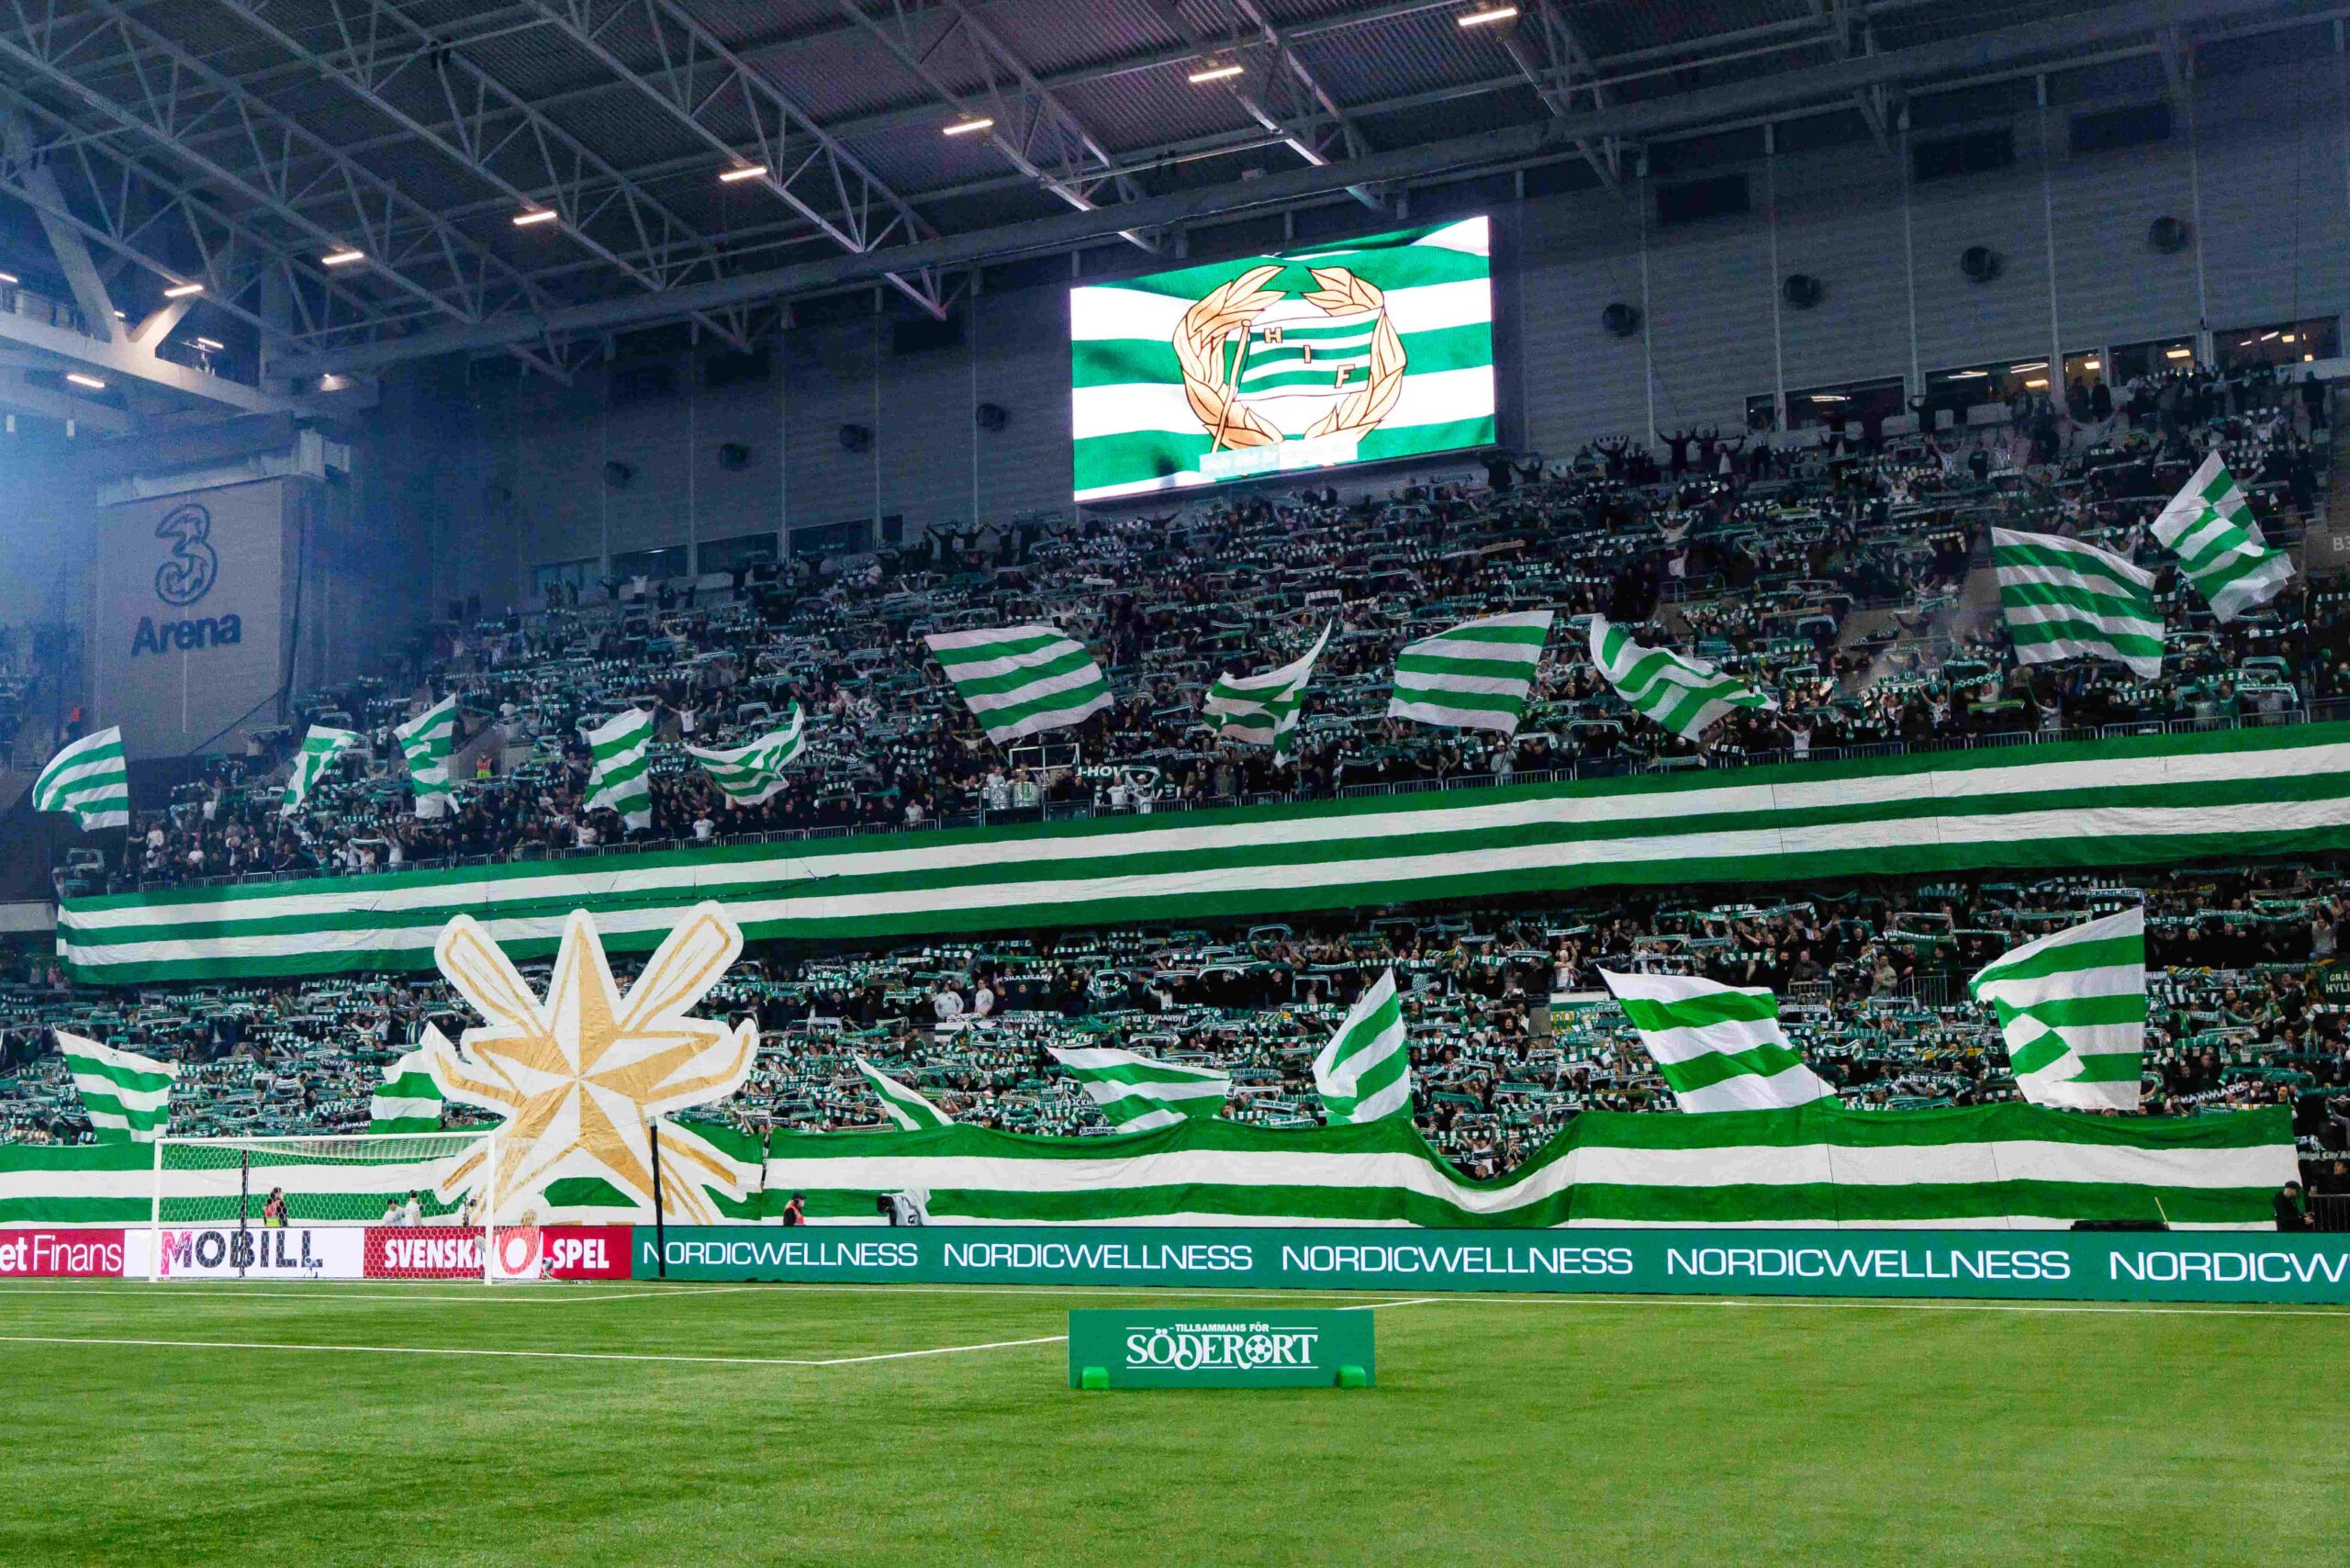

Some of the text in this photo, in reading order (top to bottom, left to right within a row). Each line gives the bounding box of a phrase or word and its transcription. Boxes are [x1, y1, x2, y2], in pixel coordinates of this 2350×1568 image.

[1263, 326, 1283, 344] H
[1333, 364, 1356, 389] F
[130, 613, 242, 656] Arena
[33, 1234, 121, 1272] Finans
[161, 1230, 323, 1275] MOBILL
[553, 1238, 610, 1269] SPEL
[643, 1241, 918, 1267] NORDICWELLNESS
[944, 1243, 1253, 1271] NORDICWELLNESS
[1282, 1246, 1633, 1274] NORDICWELLNESS
[1667, 1248, 2071, 1280] NORDICWELLNESS
[1175, 1322, 1270, 1332] TILLSAMMANS FÖR
[1125, 1327, 1319, 1371] SÖDERORT
